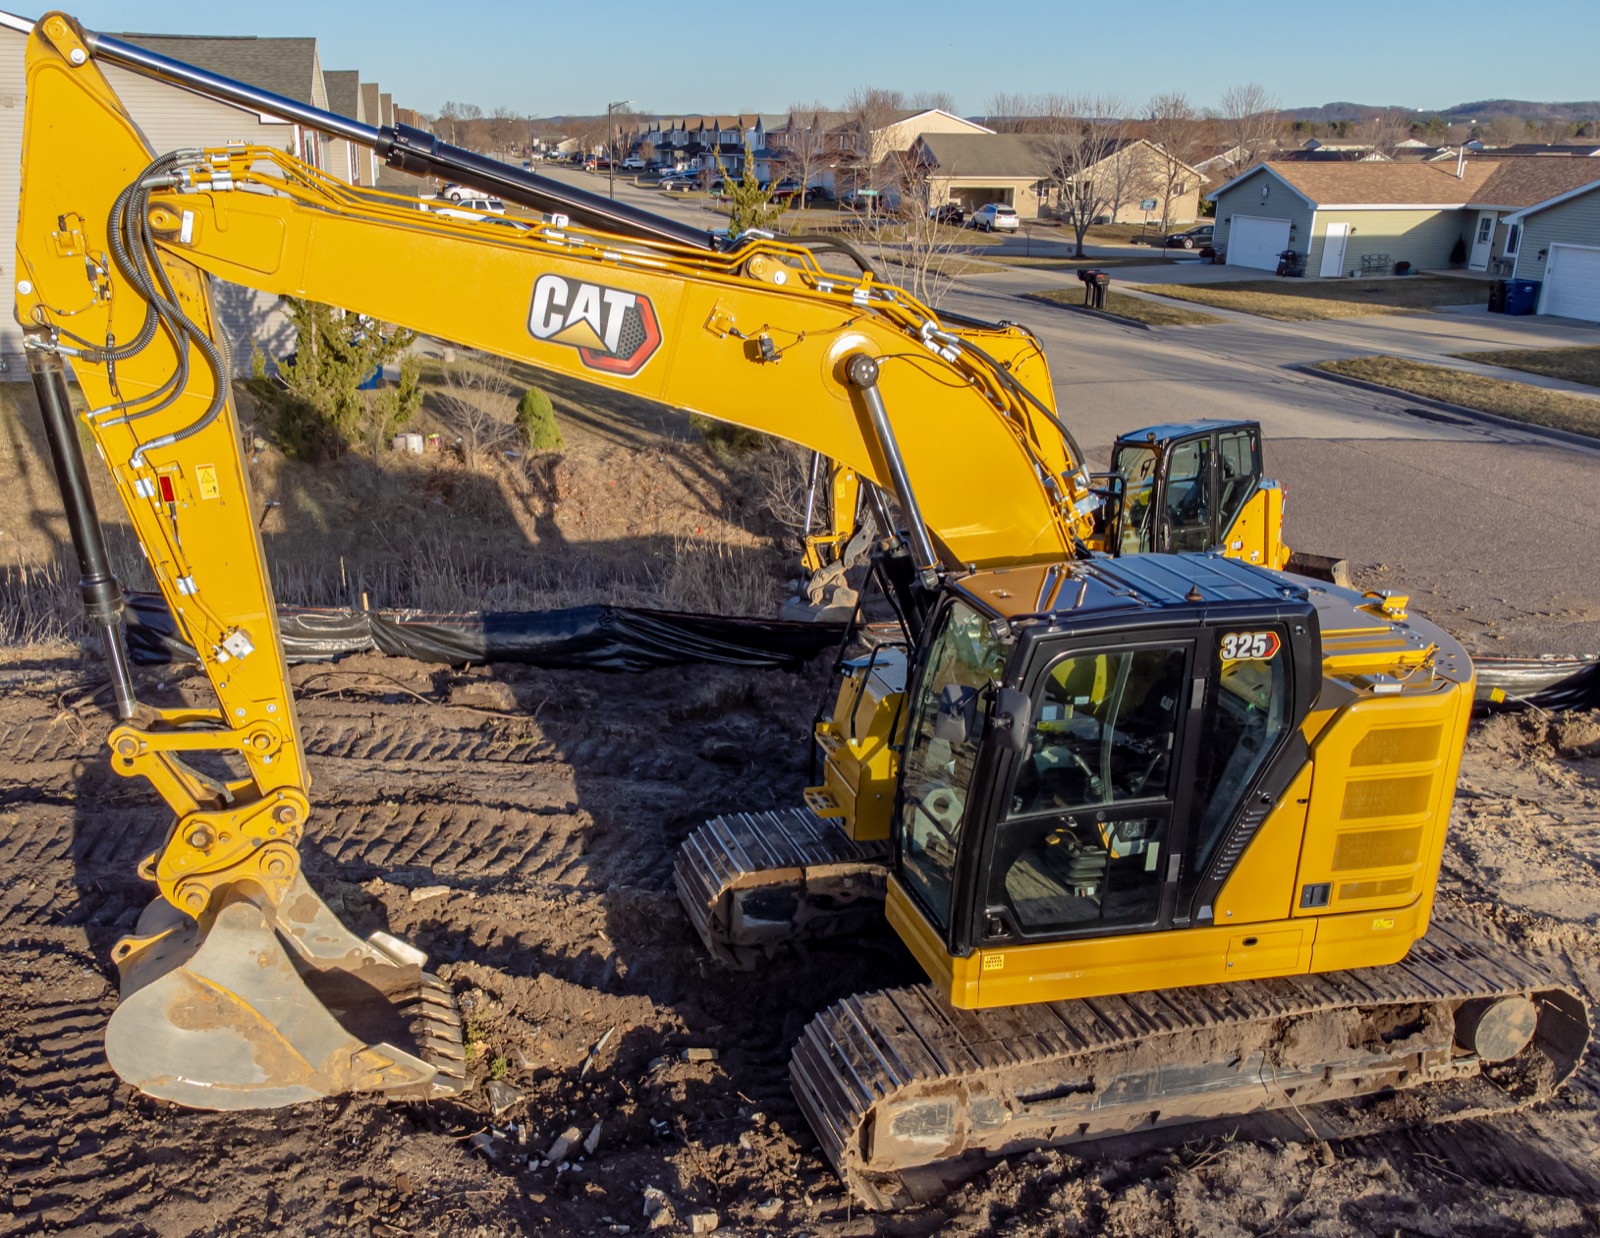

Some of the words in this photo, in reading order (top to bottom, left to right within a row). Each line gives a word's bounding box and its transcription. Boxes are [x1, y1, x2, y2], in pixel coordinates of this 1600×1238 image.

[530, 275, 637, 354] CAT
[1222, 634, 1267, 659] 325
[1160, 695, 1174, 711] CAT
